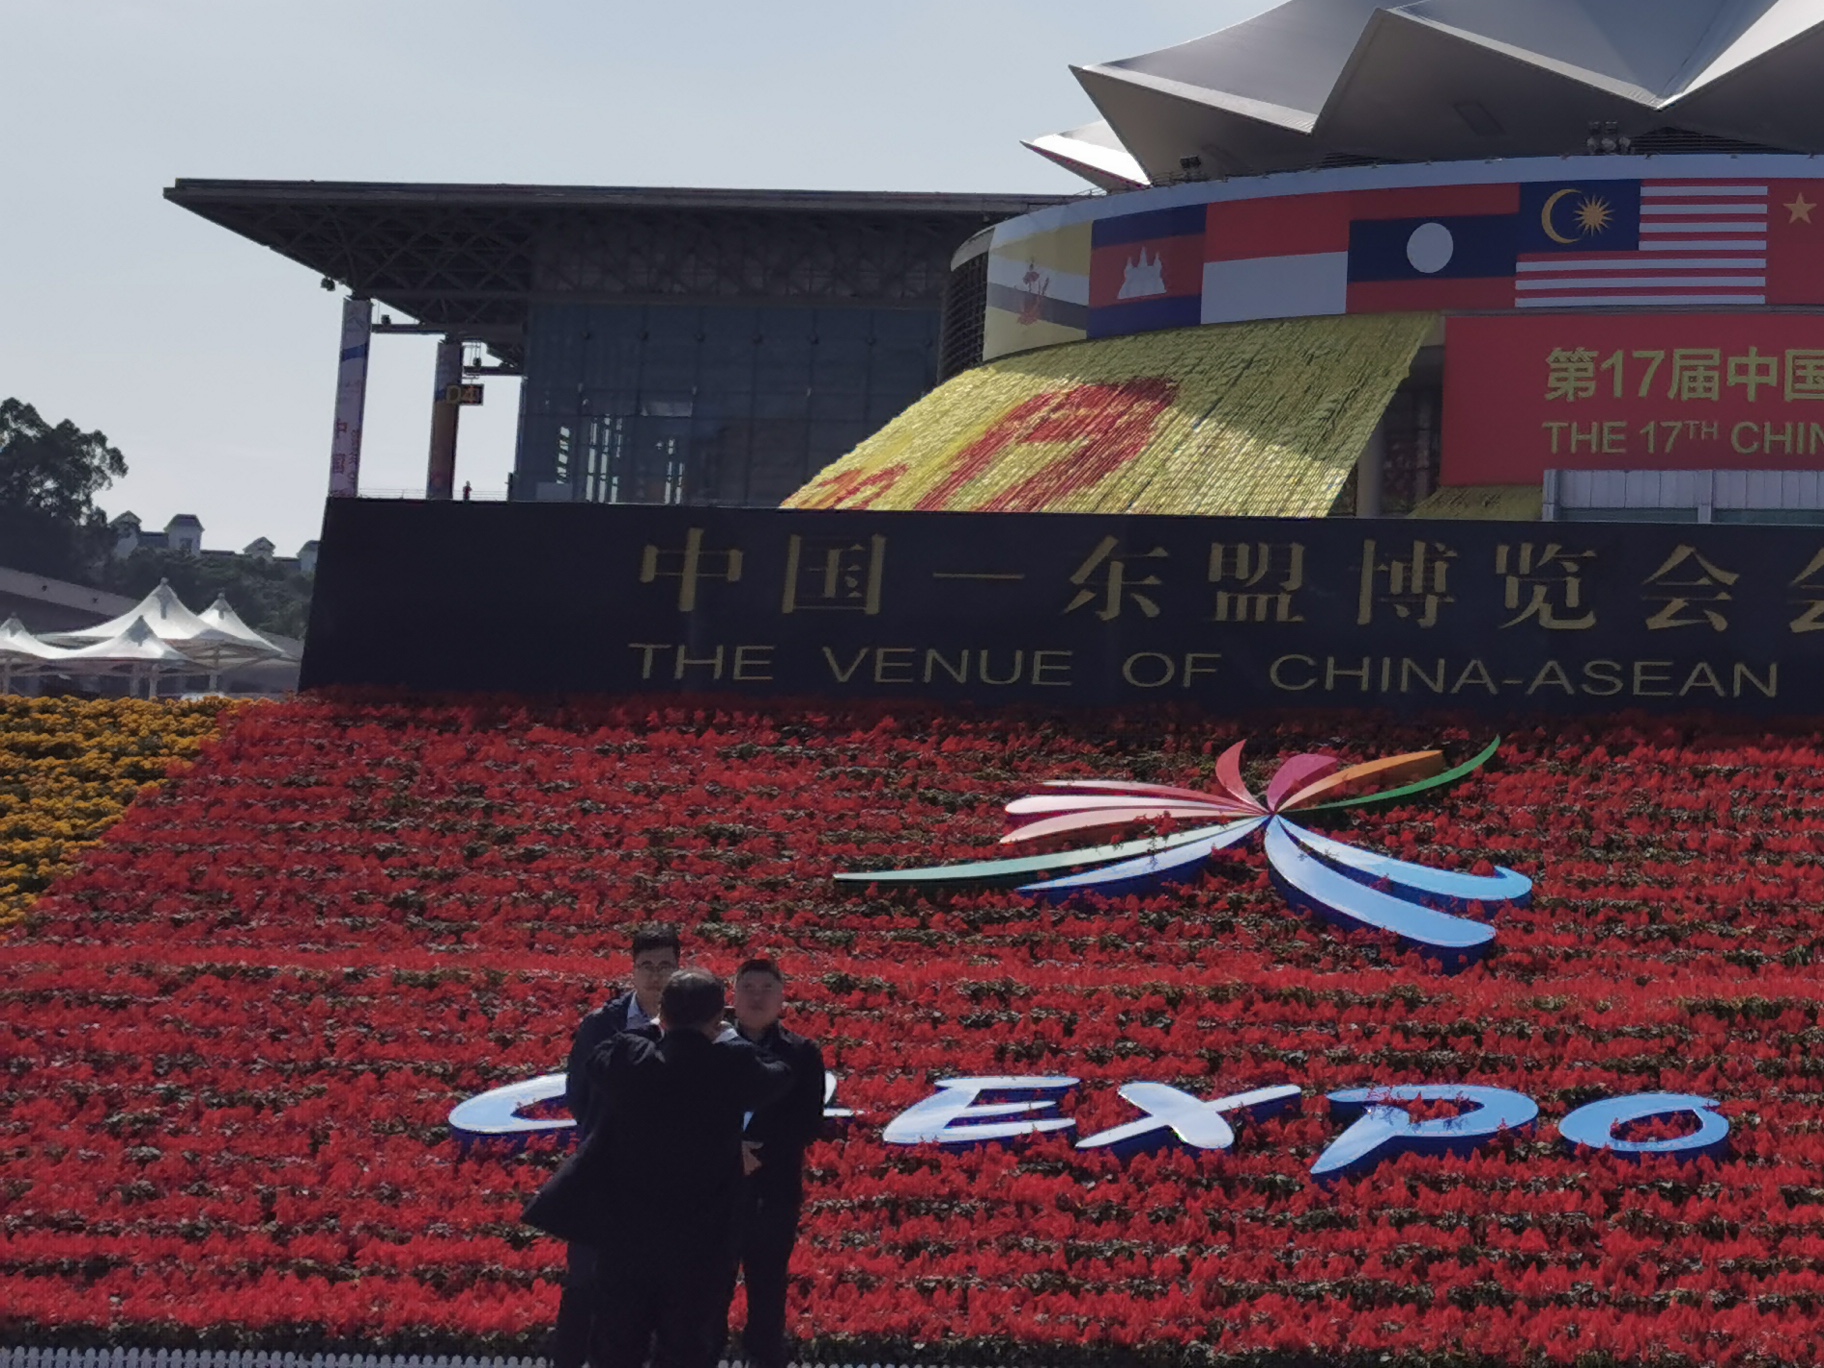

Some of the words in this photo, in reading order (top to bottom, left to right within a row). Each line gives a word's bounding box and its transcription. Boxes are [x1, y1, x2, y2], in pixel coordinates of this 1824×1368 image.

[1542, 421, 1627, 453] THE
[1640, 420, 1718, 453] 17TH
[629, 643, 774, 680] THE
[823, 647, 1072, 685] VENUE
[1123, 652, 1221, 687] OF
[1270, 654, 1777, 697] CHINA-ASEAN
